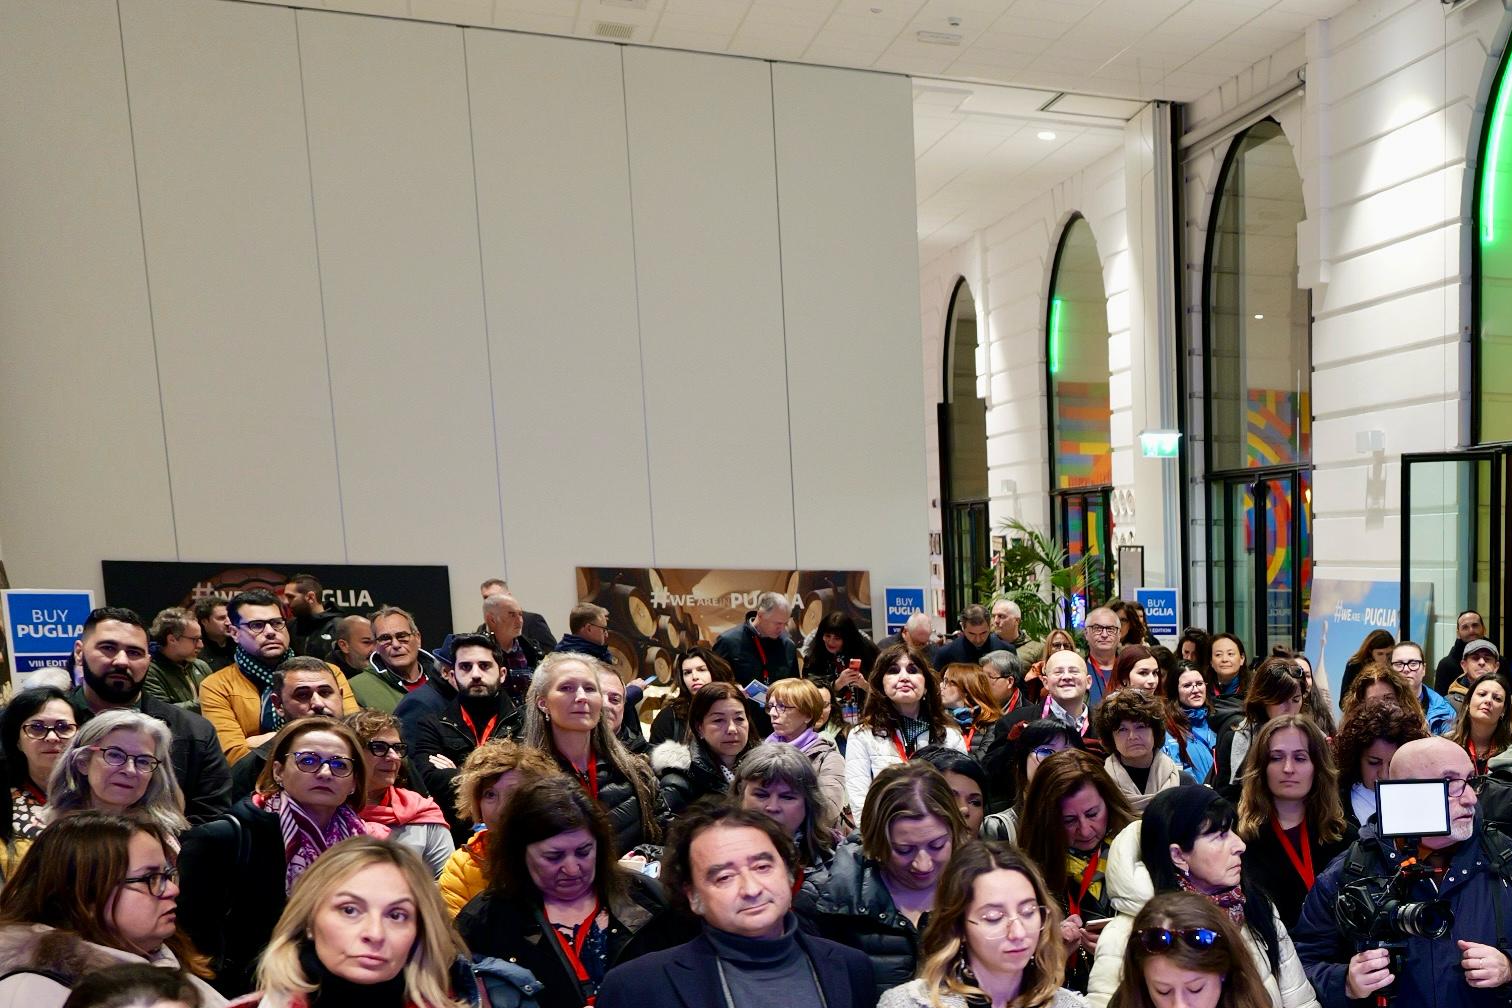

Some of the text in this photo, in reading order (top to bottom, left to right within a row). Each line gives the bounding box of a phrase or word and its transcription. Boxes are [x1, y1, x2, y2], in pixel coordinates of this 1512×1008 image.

[895, 597, 913, 606] BUY
[1147, 599, 1166, 607] BUY
[31, 609, 68, 623] BUY
[1145, 608, 1174, 616] UGLIA
[1364, 608, 1397, 627] PUGLIA
[28, 660, 45, 668] VIII
